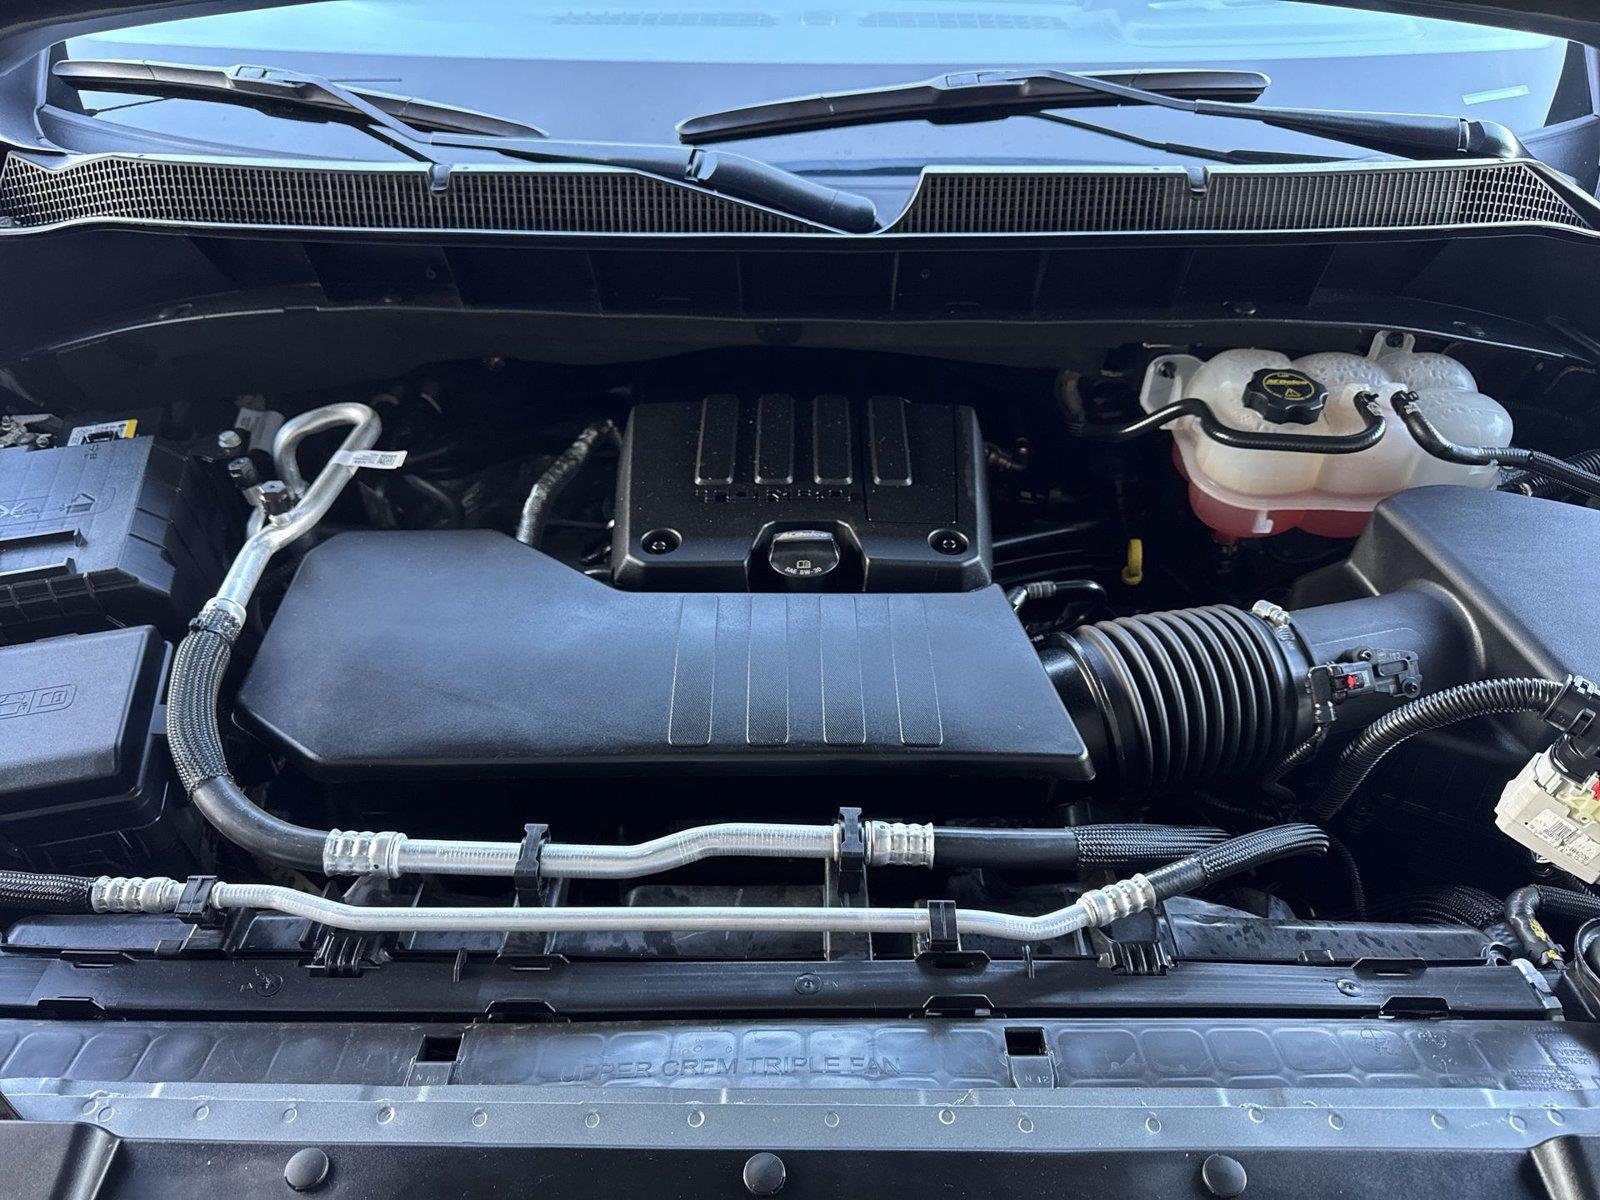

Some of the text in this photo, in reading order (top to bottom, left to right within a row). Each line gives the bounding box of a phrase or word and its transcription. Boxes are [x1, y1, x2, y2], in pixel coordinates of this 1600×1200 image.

[560, 1061, 652, 1083] UPPER
[745, 1056, 841, 1075] TRIPLE
[849, 1056, 901, 1075] FAN
